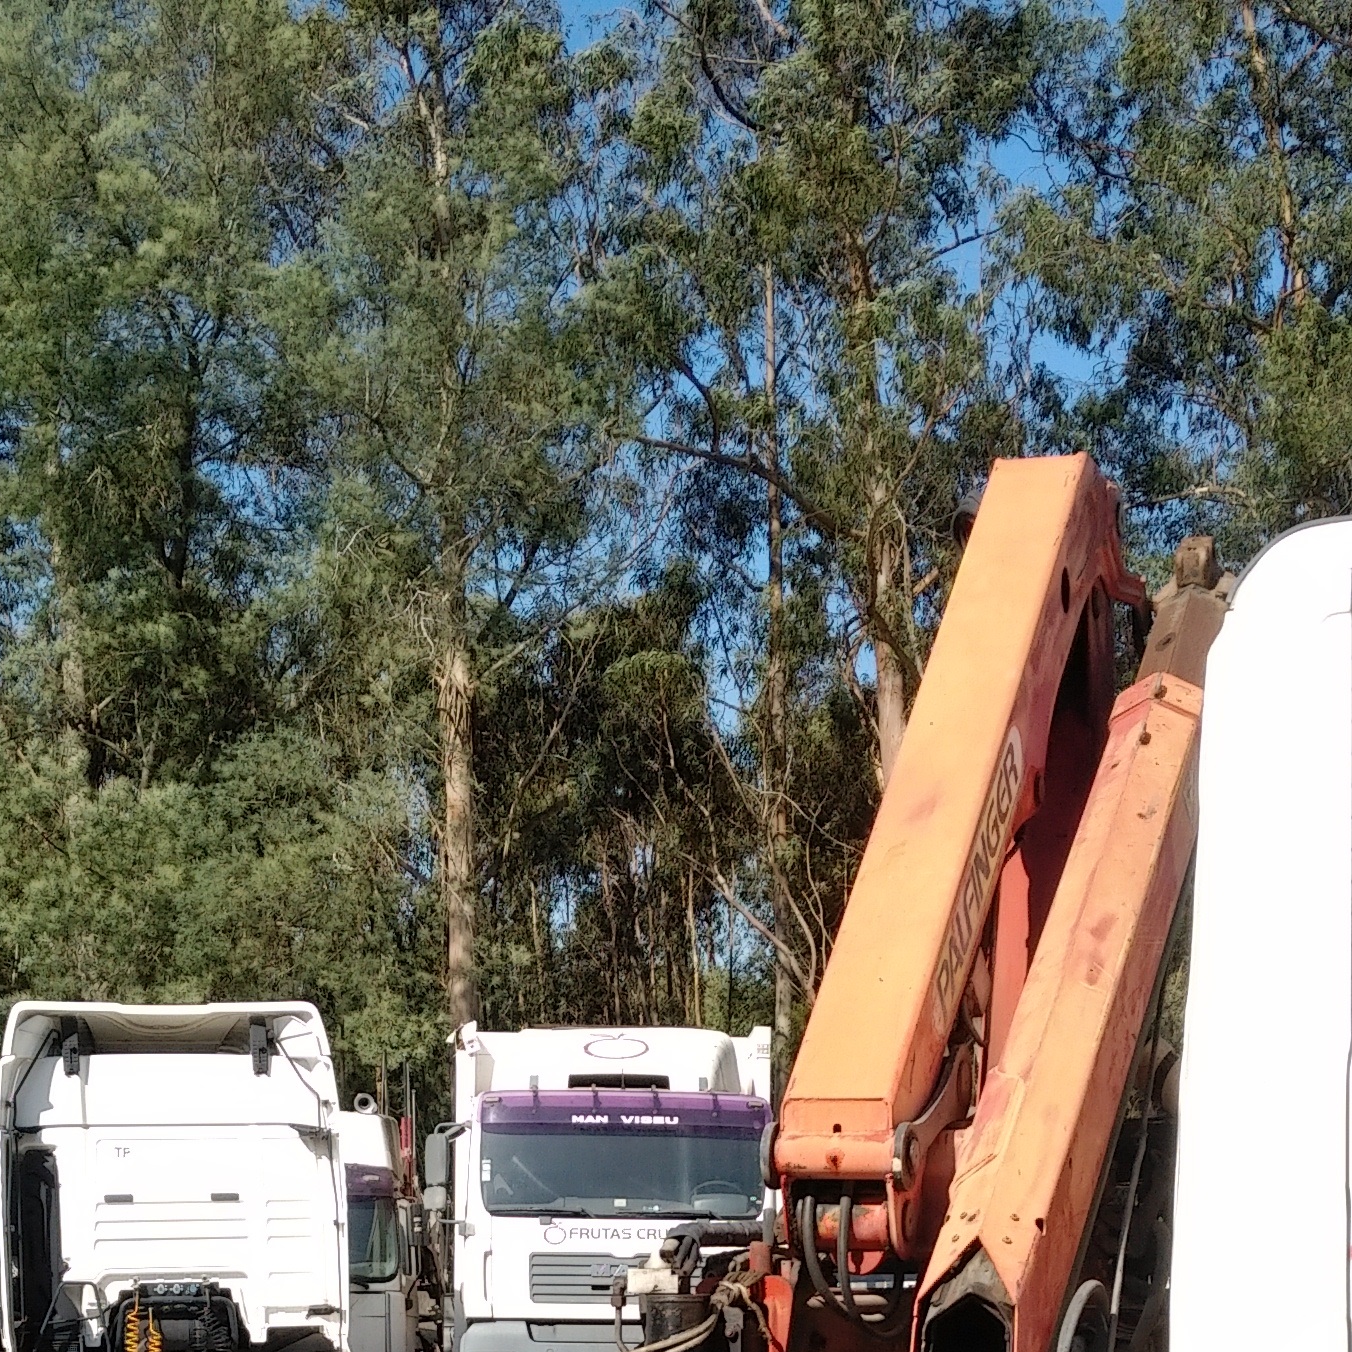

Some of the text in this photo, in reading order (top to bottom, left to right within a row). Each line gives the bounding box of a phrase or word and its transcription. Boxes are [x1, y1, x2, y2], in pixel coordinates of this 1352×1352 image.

[936, 742, 1020, 1011] PALFINGER
[571, 1114, 680, 1125] MAN VISEU
[569, 1227, 632, 1240] FRUTAS
